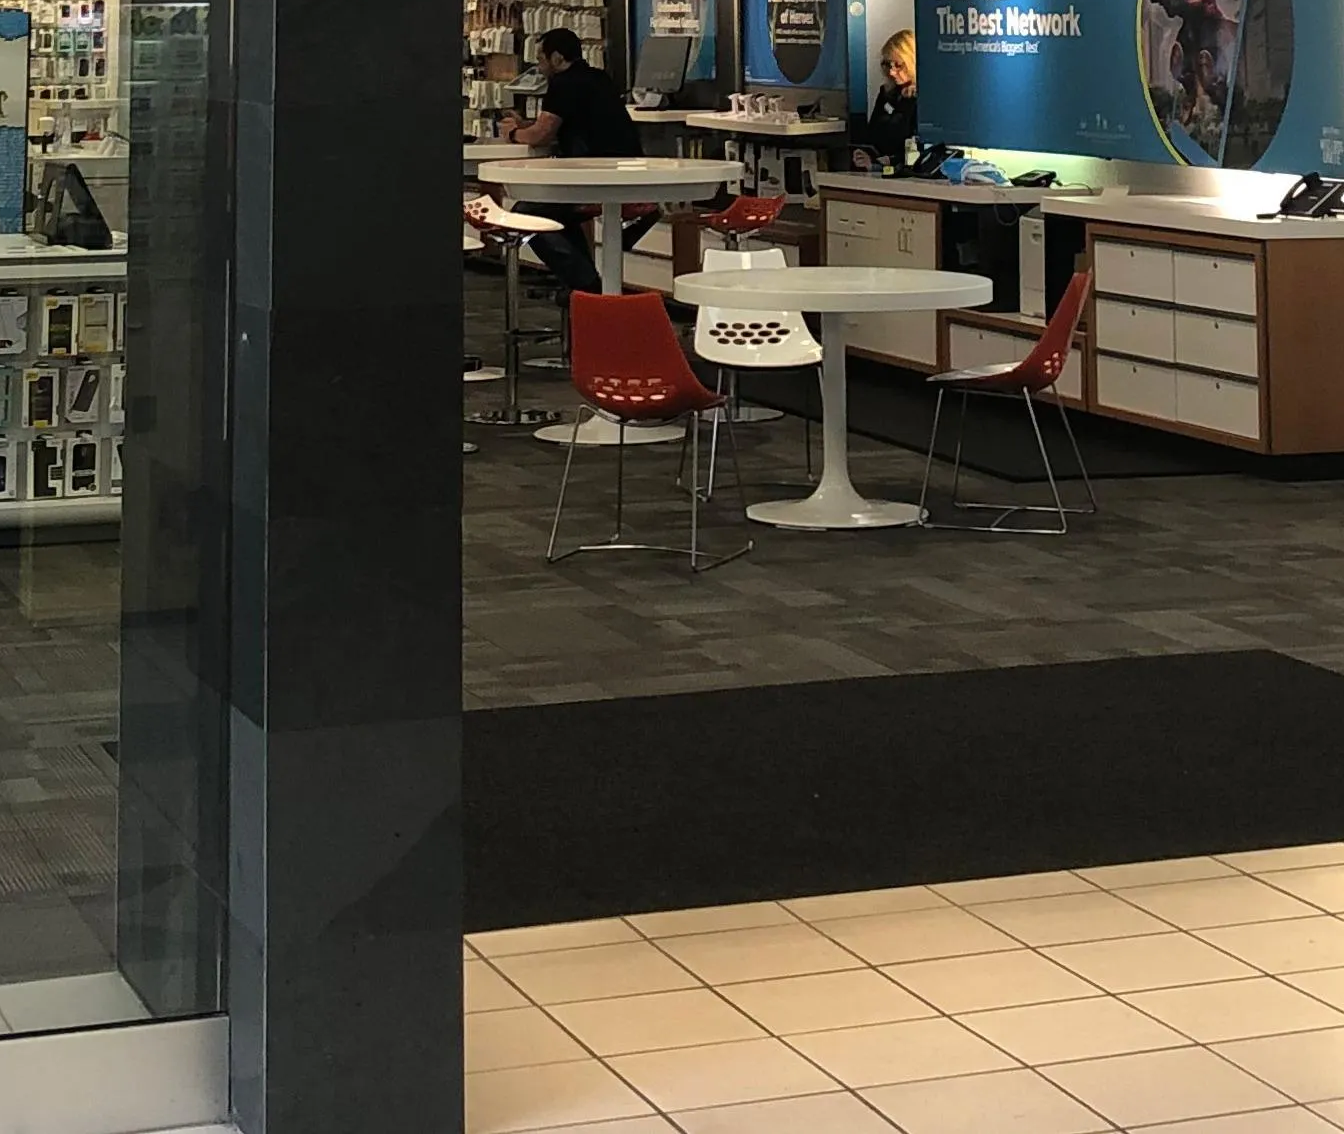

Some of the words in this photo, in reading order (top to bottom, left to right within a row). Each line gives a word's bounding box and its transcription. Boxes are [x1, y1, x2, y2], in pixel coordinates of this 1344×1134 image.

[936, 5, 964, 35] The
[967, 6, 1003, 36] Best
[1006, 5, 1082, 37] Network
